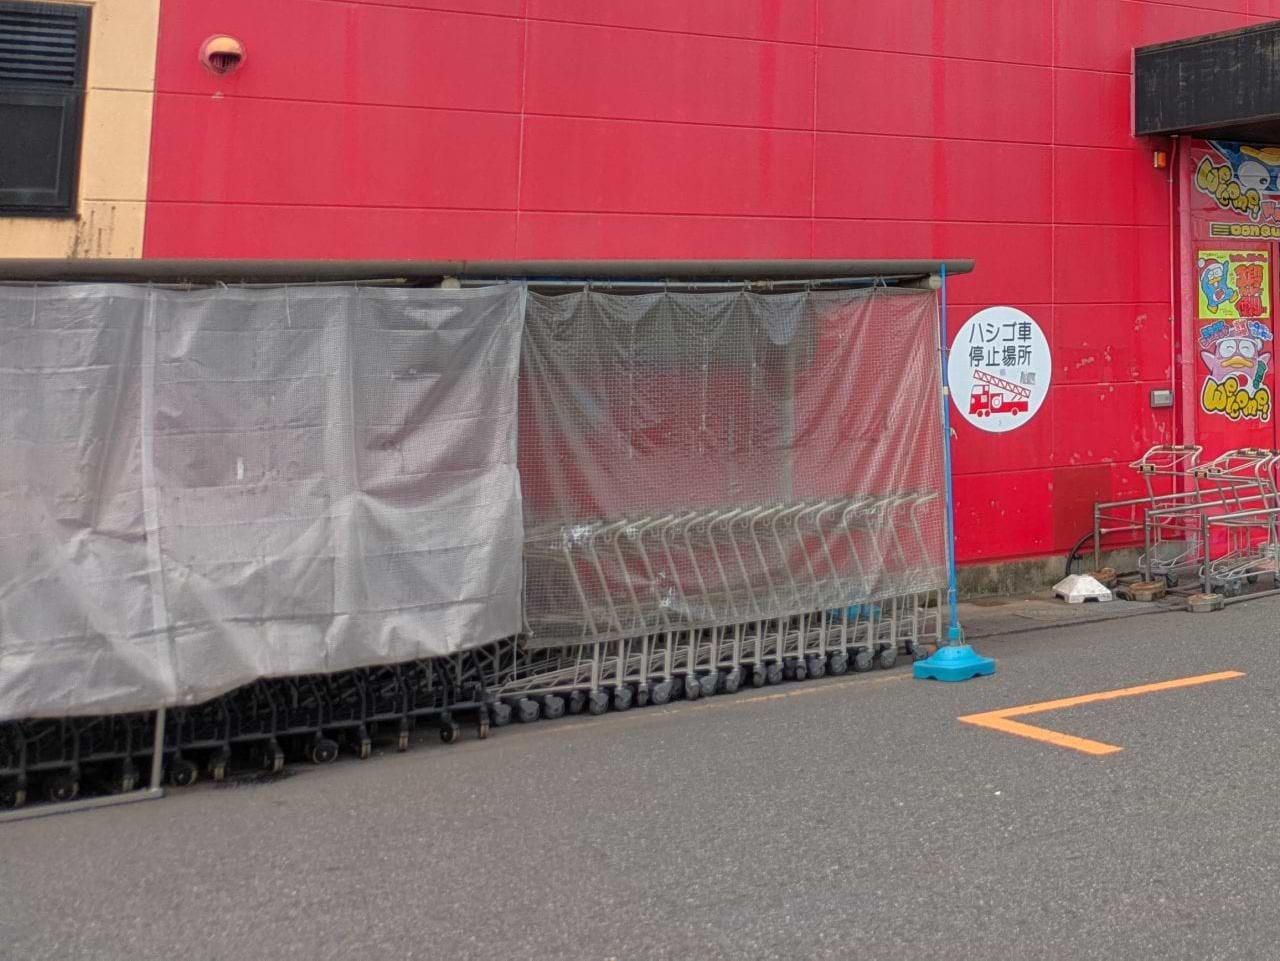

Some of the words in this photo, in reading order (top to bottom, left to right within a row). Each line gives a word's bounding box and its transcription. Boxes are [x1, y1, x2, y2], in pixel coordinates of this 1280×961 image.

[968, 321, 1033, 343] ハシゴ車
[968, 345, 1033, 368] 停止場所
